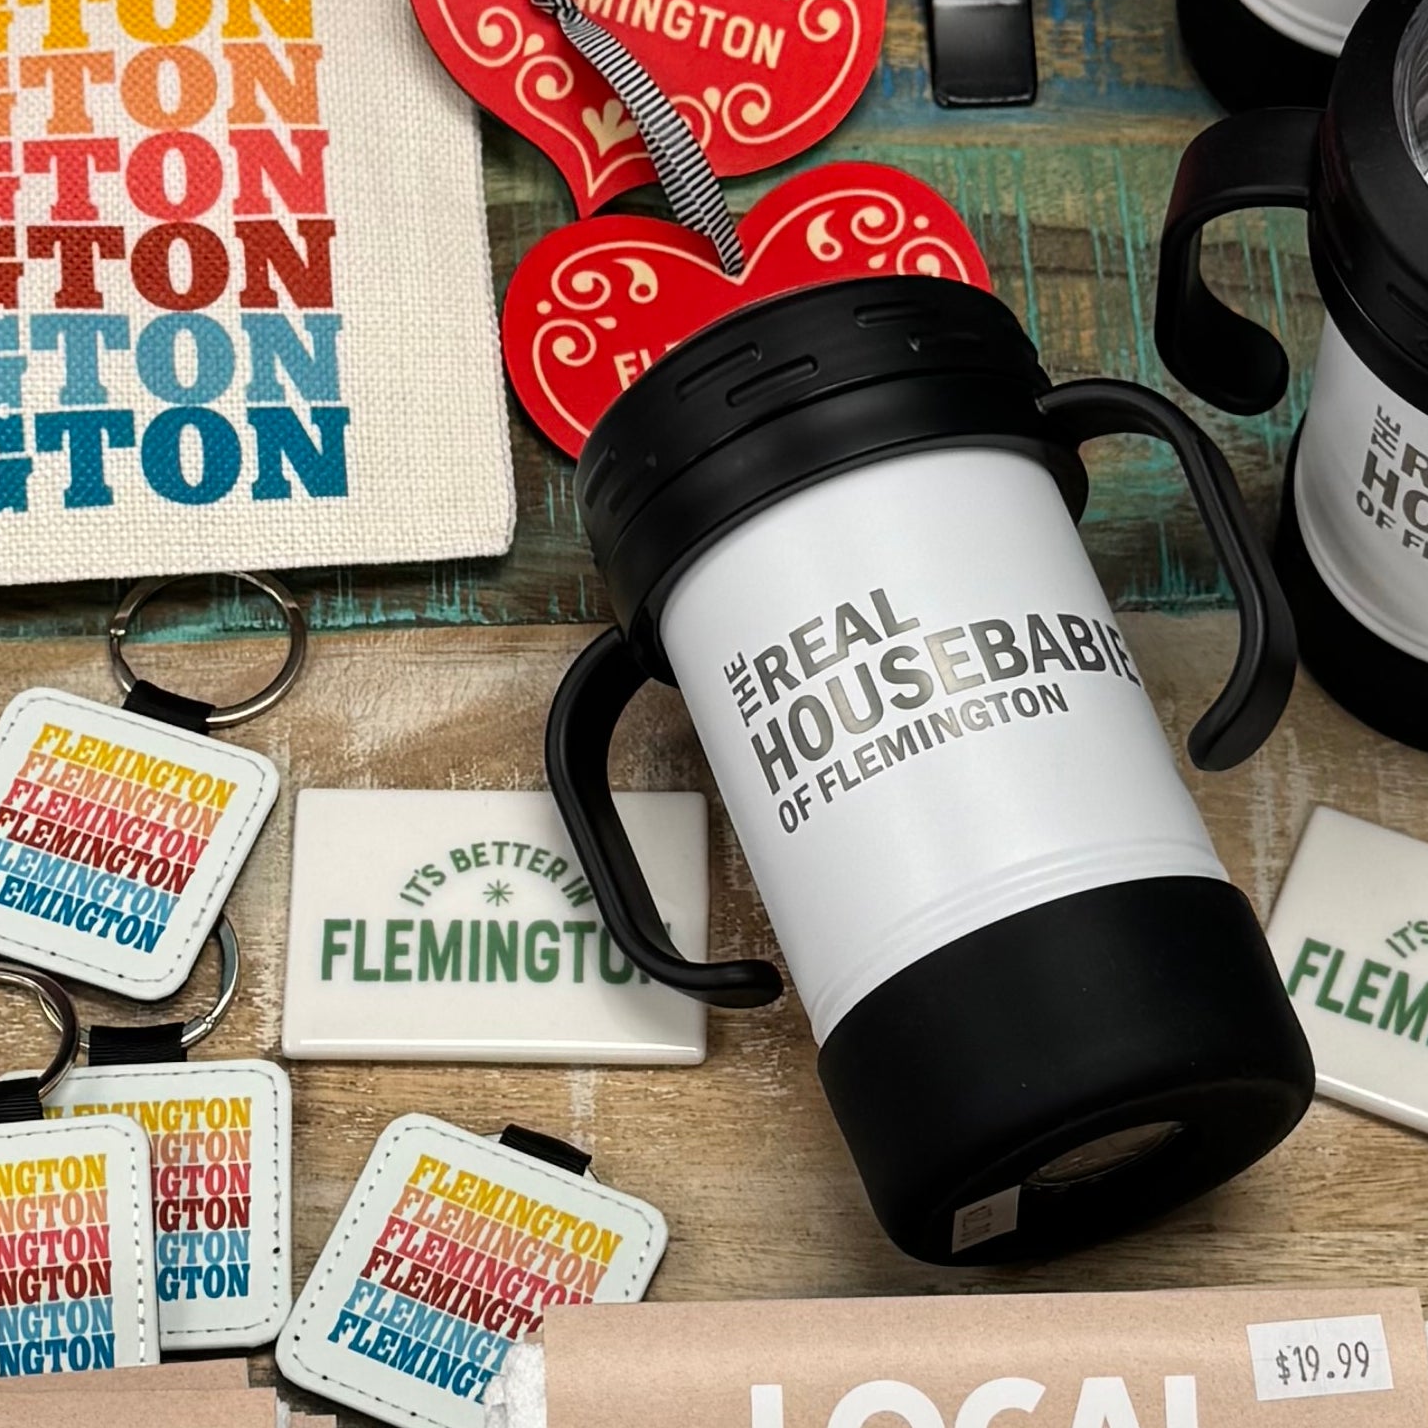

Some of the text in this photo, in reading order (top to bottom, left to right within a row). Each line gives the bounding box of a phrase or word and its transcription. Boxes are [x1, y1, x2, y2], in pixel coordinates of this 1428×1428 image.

[1371, 403, 1403, 461] THE
[1355, 489, 1399, 532] OF
[722, 650, 763, 728] THE
[752, 587, 922, 706] REAL
[17, 749, 224, 839] FLEMINGTON
[31, 722, 239, 811] FLEMINGTON
[777, 682, 1071, 835] OF FLEMINGTON
[2, 777, 209, 868] FLEMINGTON
[398, 839, 595, 910] IT'S BETTER IN
[391, 1184, 609, 1297] FLEMINGTON
[406, 1153, 624, 1264] FLEMINGTON
[1275, 1339, 1372, 1386] $19.99
